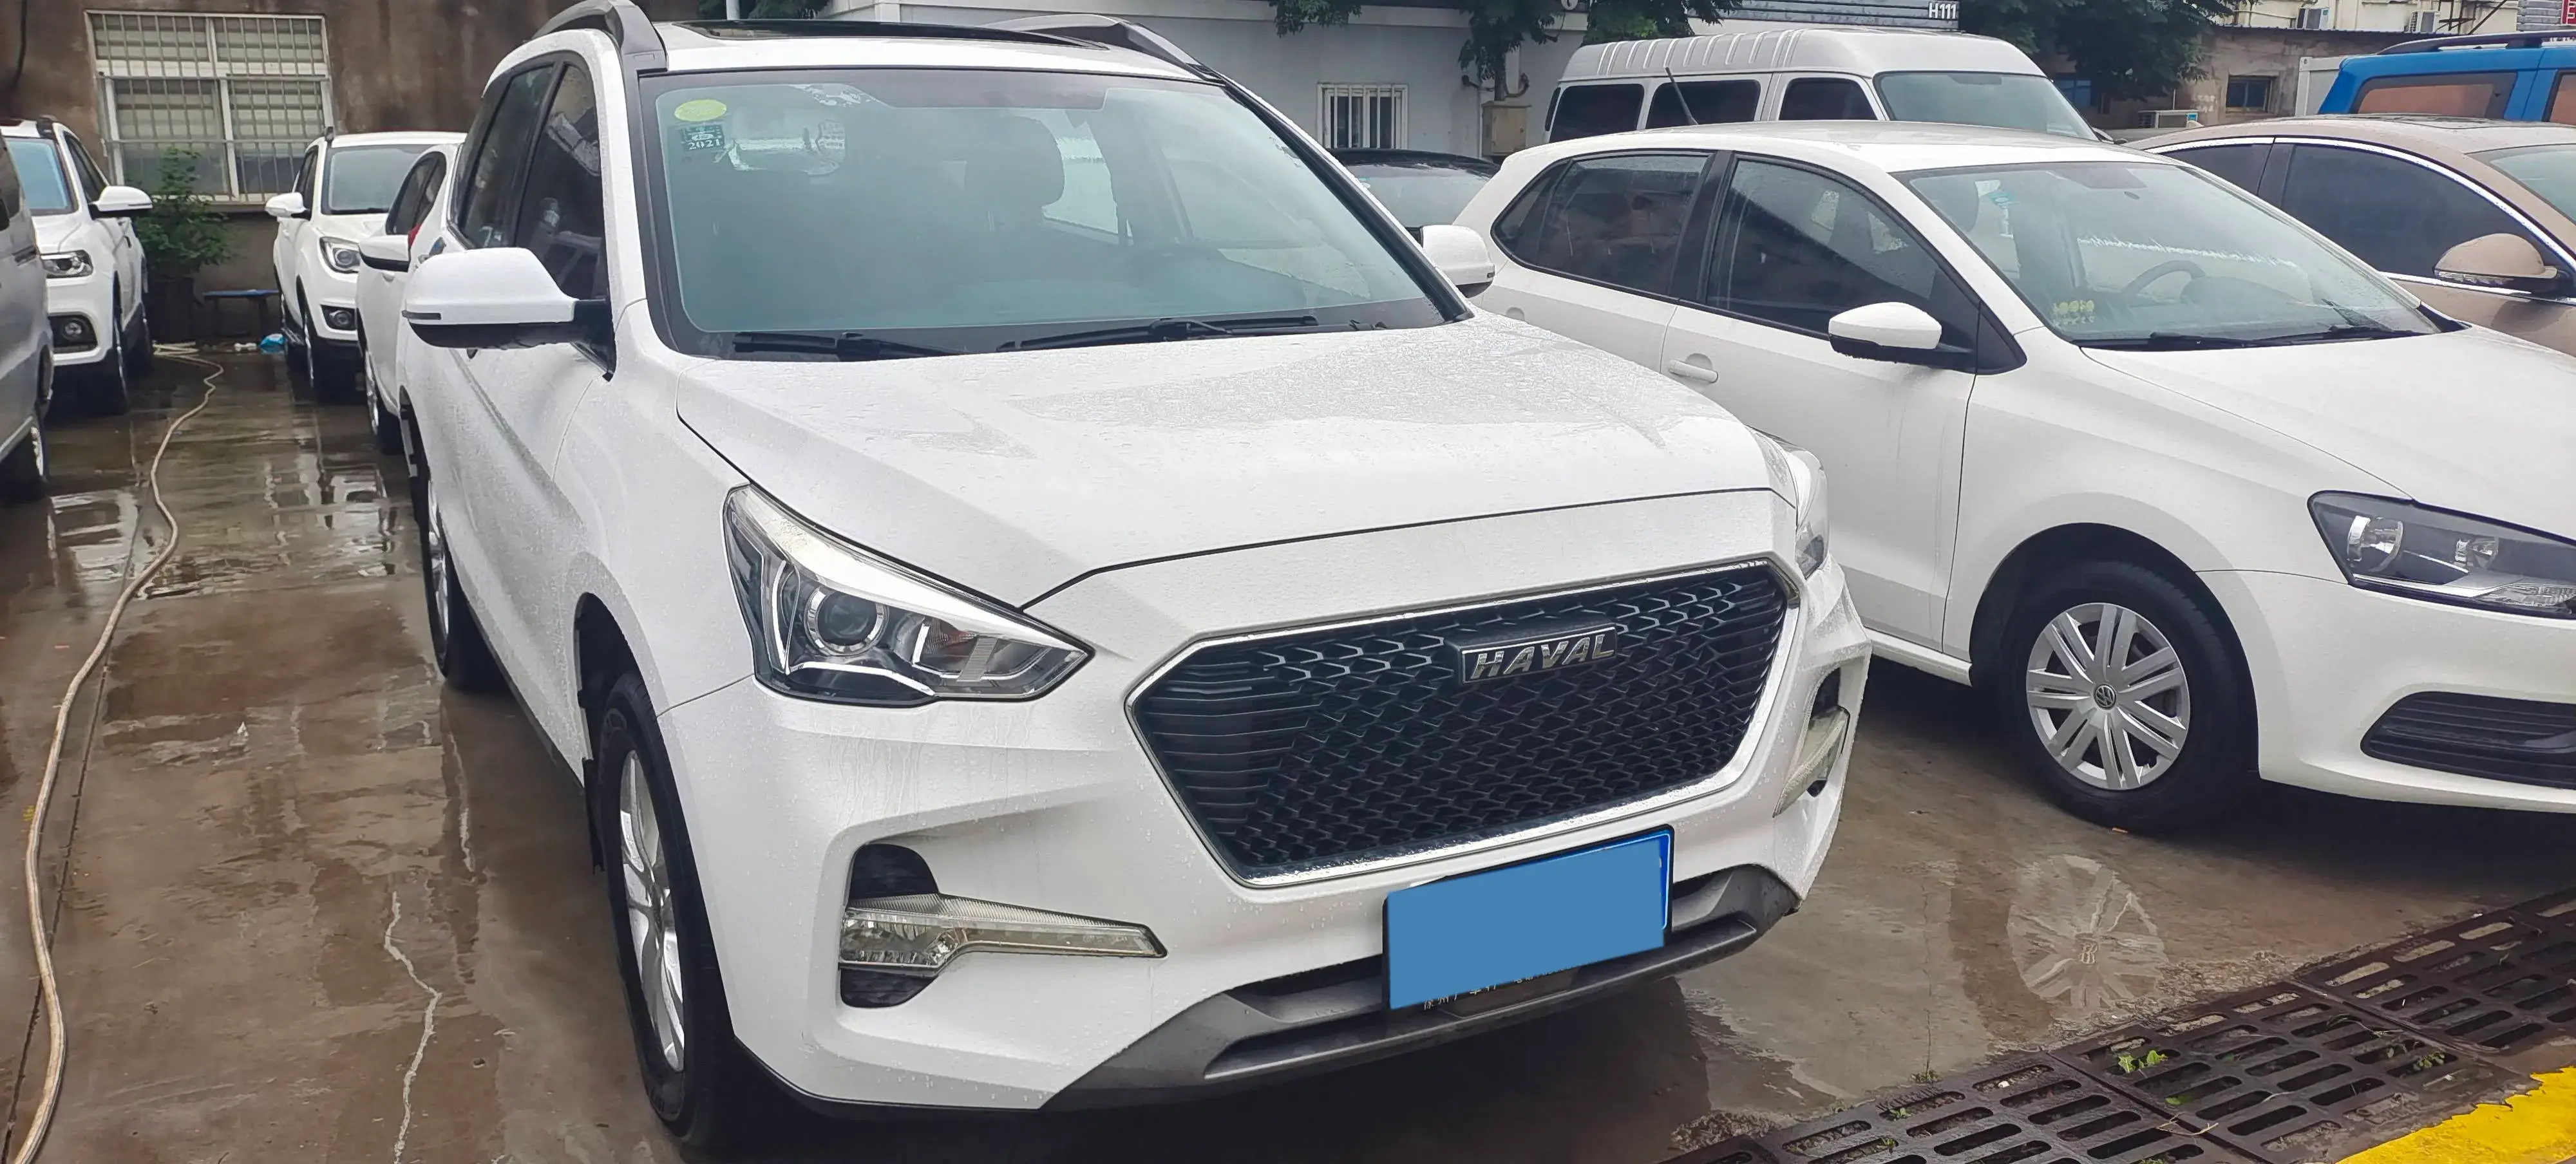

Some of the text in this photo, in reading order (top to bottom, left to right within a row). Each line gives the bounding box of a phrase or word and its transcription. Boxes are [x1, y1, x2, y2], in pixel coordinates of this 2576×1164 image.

[1928, 2, 1956, 19] H111
[688, 138, 721, 149] 2021
[1470, 634, 1615, 680] HAVAL
